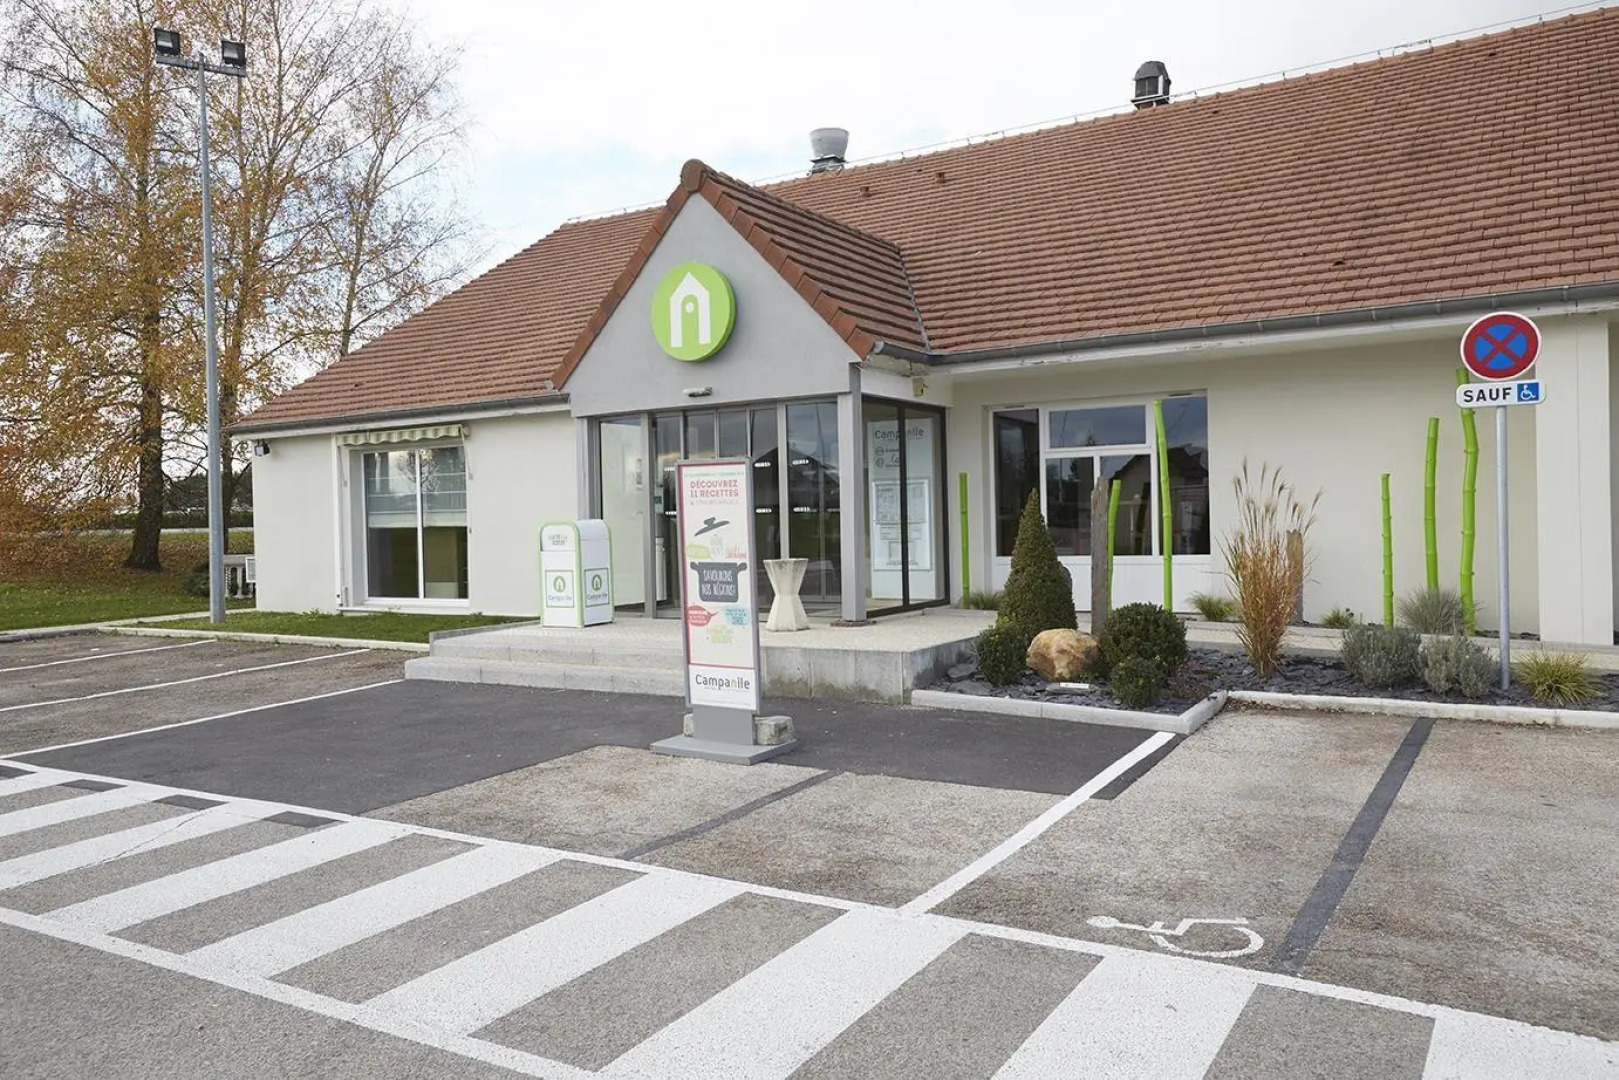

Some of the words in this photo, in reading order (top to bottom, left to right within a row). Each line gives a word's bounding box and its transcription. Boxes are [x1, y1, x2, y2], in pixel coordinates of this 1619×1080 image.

[1463, 387, 1512, 403] SAUF
[874, 426, 925, 441] Campnile
[690, 479, 738, 489] DÉCOUVREZ
[690, 490, 698, 498] 11
[700, 489, 739, 498] RECETTES
[695, 674, 750, 690] Campanile
